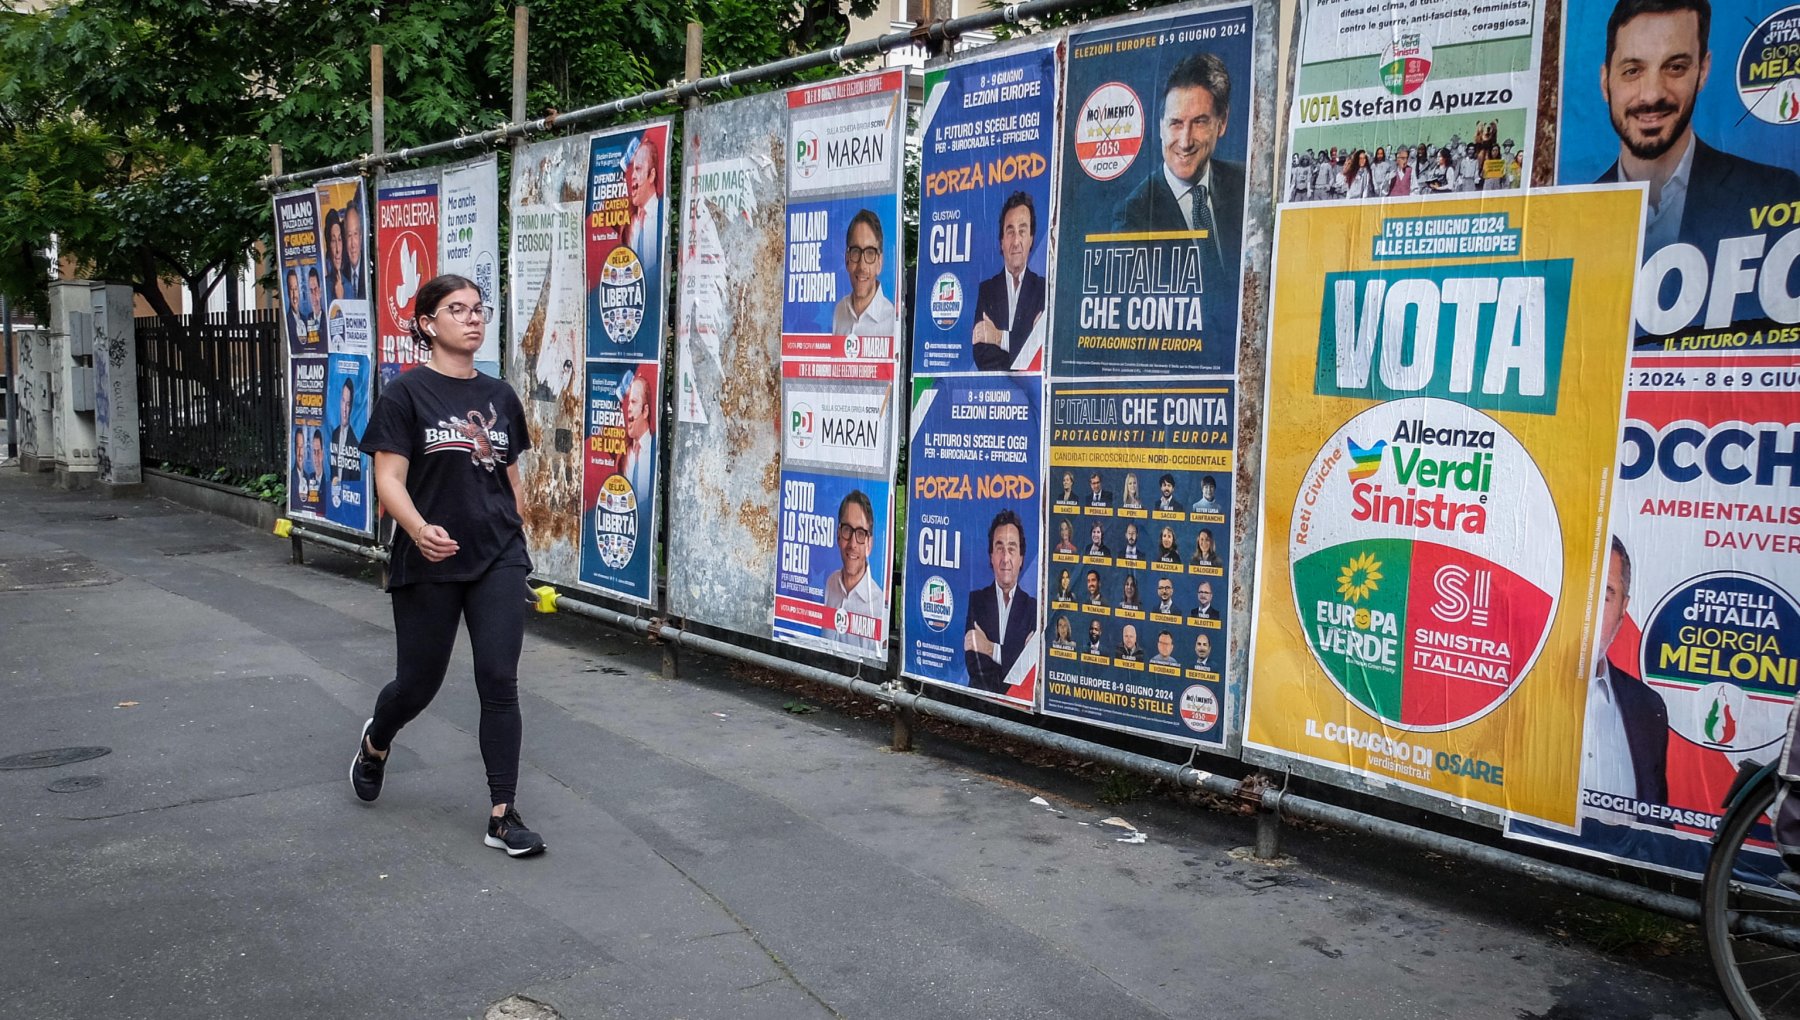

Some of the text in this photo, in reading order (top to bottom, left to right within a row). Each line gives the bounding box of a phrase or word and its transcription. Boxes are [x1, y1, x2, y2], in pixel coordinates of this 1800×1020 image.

[1340, 5, 1377, 18] difesa del
[1340, 23, 1365, 34] contro
[1411, 7, 1471, 24] anti-fascista,
[1473, 0, 1531, 15] femminista,
[1472, 19, 1529, 32] coraggiosa.
[1075, 23, 1246, 58] ELEZIONI EUROPEE 8-9 GIUGNO 2024
[997, 69, 1023, 85] GIUGNO
[964, 81, 1041, 108] ELEZIONI EUROPEE
[1300, 88, 1513, 123] VOTA Stefano Apuzzo
[936, 112, 1039, 141] IL FUTURO SI SCEGLIE OGGI
[827, 133, 883, 168] MARAN
[936, 129, 1039, 154] PER BUROCRAZIA EFFICIENZA
[1096, 141, 1120, 157] 2050
[594, 173, 615, 184] DIFENDI
[690, 172, 719, 193] PRIMO
[926, 153, 1046, 198] FORZA NORD
[281, 201, 312, 220] MILANO
[382, 201, 436, 228] BASTA GUERRA
[448, 195, 476, 210] Ma anche
[605, 199, 629, 211] CATENO
[932, 210, 960, 221] GUSTAVO
[467, 209, 477, 224] sai
[517, 213, 539, 230] PRIMO
[592, 210, 630, 227] DE LUCA
[790, 211, 828, 242] MILANO
[1386, 216, 1504, 238] L'8 E GIUGNO 2024
[447, 244, 472, 261] votare?
[790, 242, 822, 272] CUORE
[930, 223, 971, 264] GILI
[1375, 235, 1517, 256] ALLE ELEZIONI EUROPEE
[1082, 246, 1203, 294] L'ITALIA
[602, 283, 642, 308] LIBERTÀ
[788, 272, 836, 303] D'EUROPA
[1080, 296, 1202, 331] CHE CONTA
[1078, 336, 1202, 351] PROTAGONISTI IN EUROPA
[1334, 276, 1546, 397] VOTA
[1664, 331, 1761, 352] IL FUTURO A
[297, 365, 324, 380] MILANO
[1639, 372, 1685, 387] 2024
[1705, 372, 1716, 386] 8
[1723, 375, 1734, 386] e
[1741, 372, 1753, 386] 9
[985, 391, 1010, 402] GIUGNO
[952, 406, 1028, 420] ELEZIONI EUROPEE
[1054, 398, 1227, 425] L'ITALIA CHE CONTA
[822, 417, 878, 448] MARAN
[925, 433, 1027, 450] IL FUTURO SI SCEGLIE OGGI
[1054, 429, 1228, 444] PROTAGONISTI IN EUROPA
[1392, 420, 1495, 449] Alleanza
[591, 437, 627, 456] DE LUCA
[925, 448, 1027, 463] PER BUROCRAZIA EFFICIENZA
[1054, 452, 1226, 466] CANDIDATI CIRCOSCRIZIONE NORD-OCCIDENTALE
[338, 458, 360, 471] EUROPA
[1392, 446, 1494, 493] Verdi
[342, 490, 360, 504] RENZI
[785, 479, 815, 512] SOTTO
[915, 474, 1035, 500] FORZA NORD
[1296, 448, 1343, 545] Reti Civiche
[1479, 493, 1488, 504] e
[598, 507, 635, 536] LIBERTÀ
[922, 514, 949, 526] GUSTAVO
[1351, 482, 1487, 535] Sinistra
[784, 511, 835, 548] LO STESSO
[782, 542, 809, 575] CIELO
[918, 527, 961, 569] GILI
[1694, 588, 1774, 610] FRATELLI
[1683, 602, 1780, 630] d'ITALIA
[1317, 625, 1397, 666] VERDE
[1414, 628, 1511, 658] SINISTRA
[1679, 626, 1780, 655] GIORGIA
[1413, 651, 1509, 682] ITALIANA
[1659, 643, 1798, 687] MELONI
[1049, 671, 1173, 700] ELEZIONI EUROPEE 8-9 GIUGNO 2024
[1049, 682, 1071, 696] VOTA
[1074, 687, 1128, 707] MOVIMENTO
[1138, 698, 1173, 715] STELLE
[1306, 719, 1504, 786] IL CORAGGIO DI OSARE
[1368, 754, 1431, 782] verdisinistra.it
